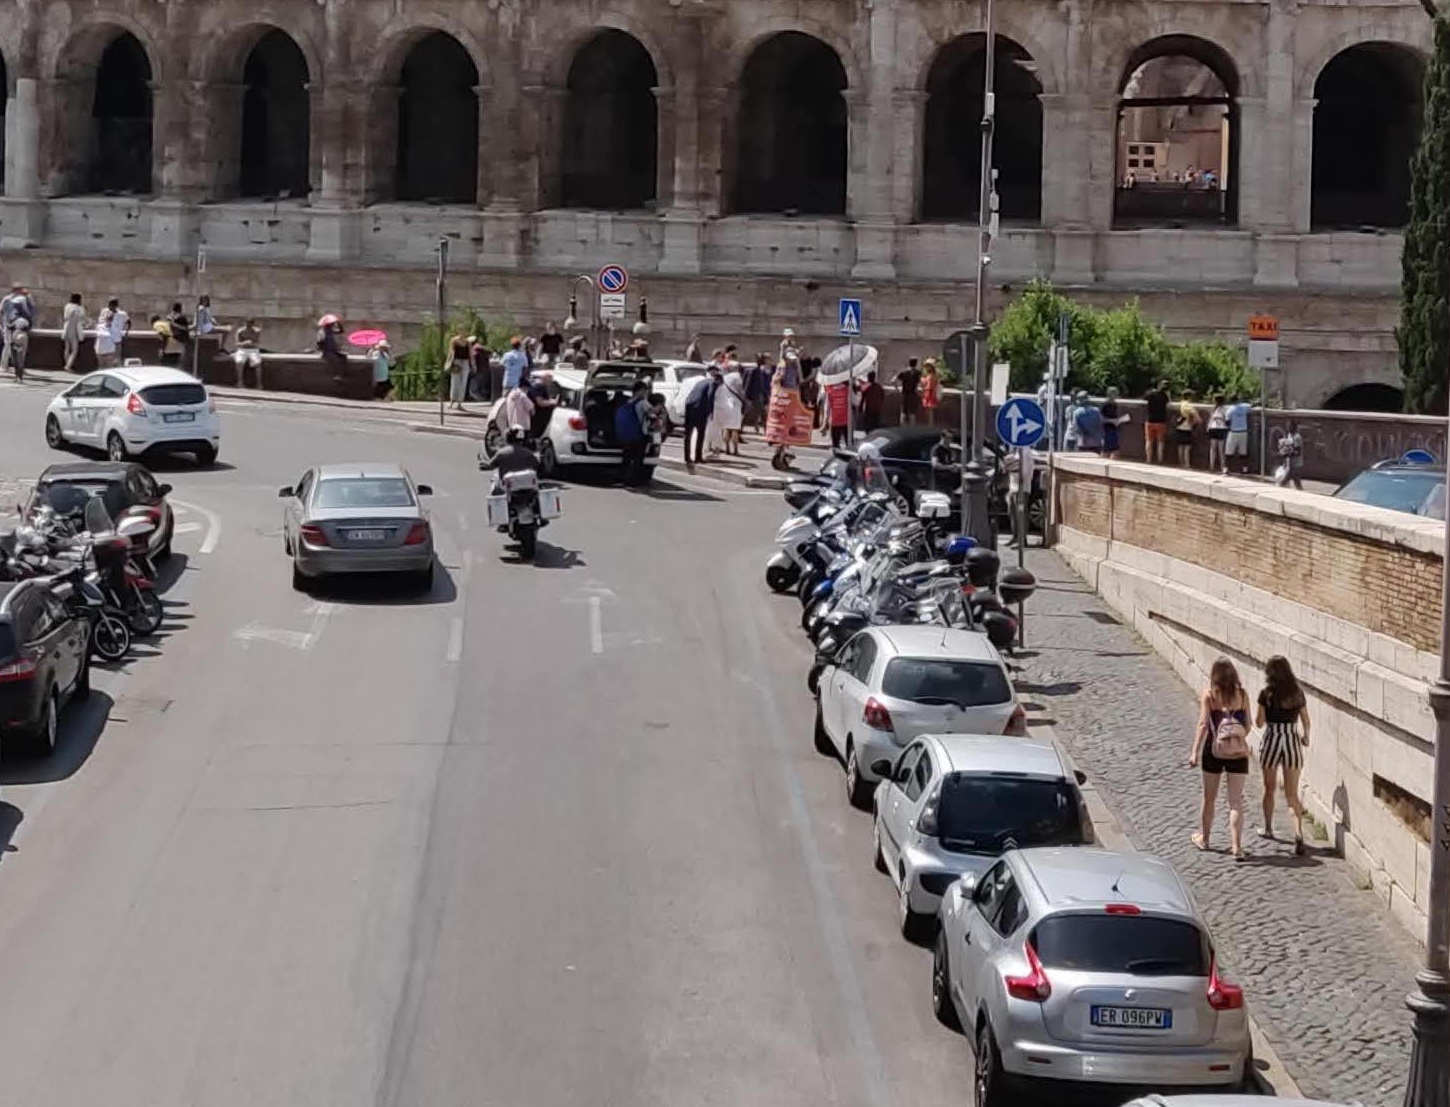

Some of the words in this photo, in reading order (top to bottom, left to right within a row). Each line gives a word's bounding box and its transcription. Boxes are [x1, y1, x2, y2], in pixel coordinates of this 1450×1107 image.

[1251, 322, 1278, 332] TAXI
[1101, 1009, 1117, 1023] ER
[1122, 1010, 1162, 1025] 096PW
